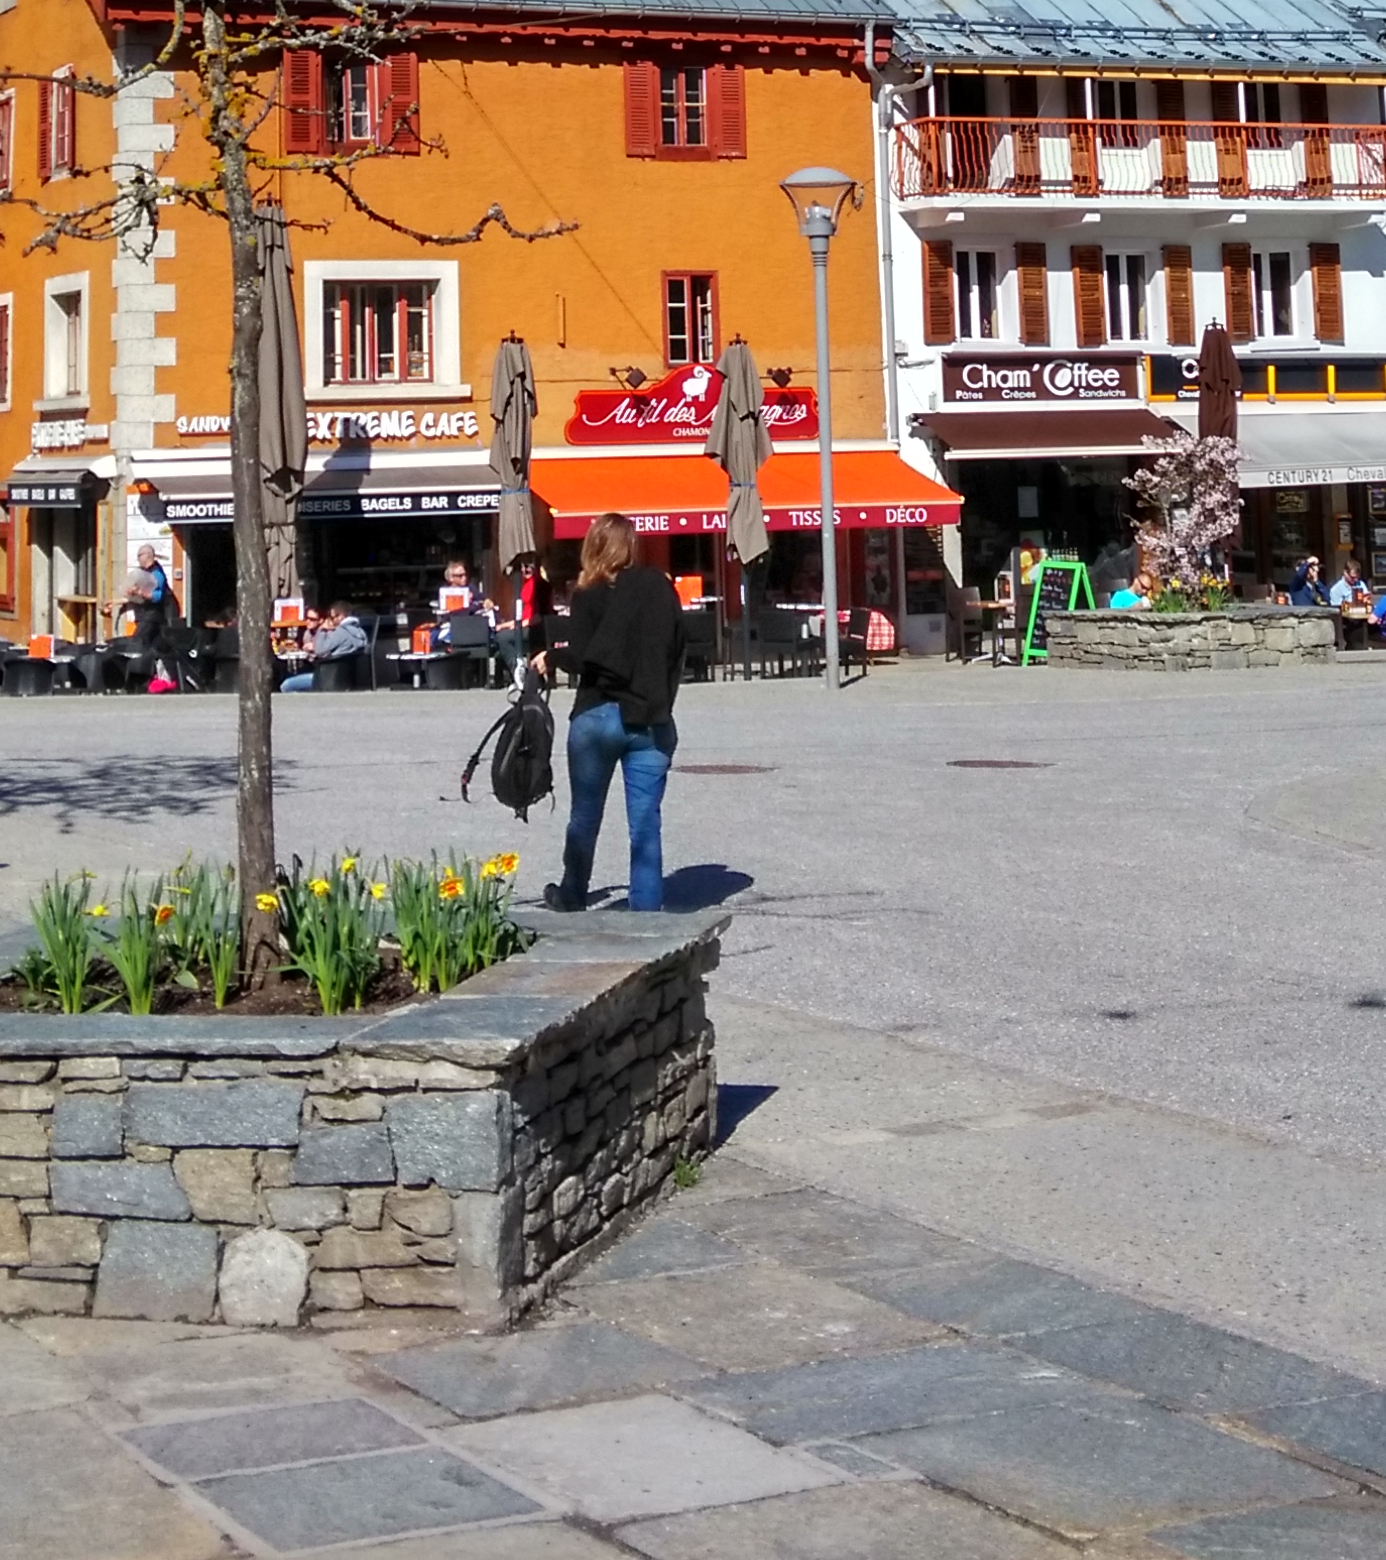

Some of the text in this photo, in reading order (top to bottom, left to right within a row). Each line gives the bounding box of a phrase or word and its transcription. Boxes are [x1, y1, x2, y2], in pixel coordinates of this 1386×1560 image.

[420, 411, 479, 437] CAFE
[673, 426, 711, 437] CHAMON
[1267, 470, 1320, 485] CENTURY
[1321, 469, 1334, 482] 21
[166, 502, 235, 518] SMOOTHIE
[360, 496, 412, 511] BAGELS
[421, 495, 449, 509] BAR
[457, 493, 501, 507] CREPE
[702, 513, 727, 529] LAI
[788, 510, 841, 526] TISSS
[885, 505, 928, 523] DÉCO
